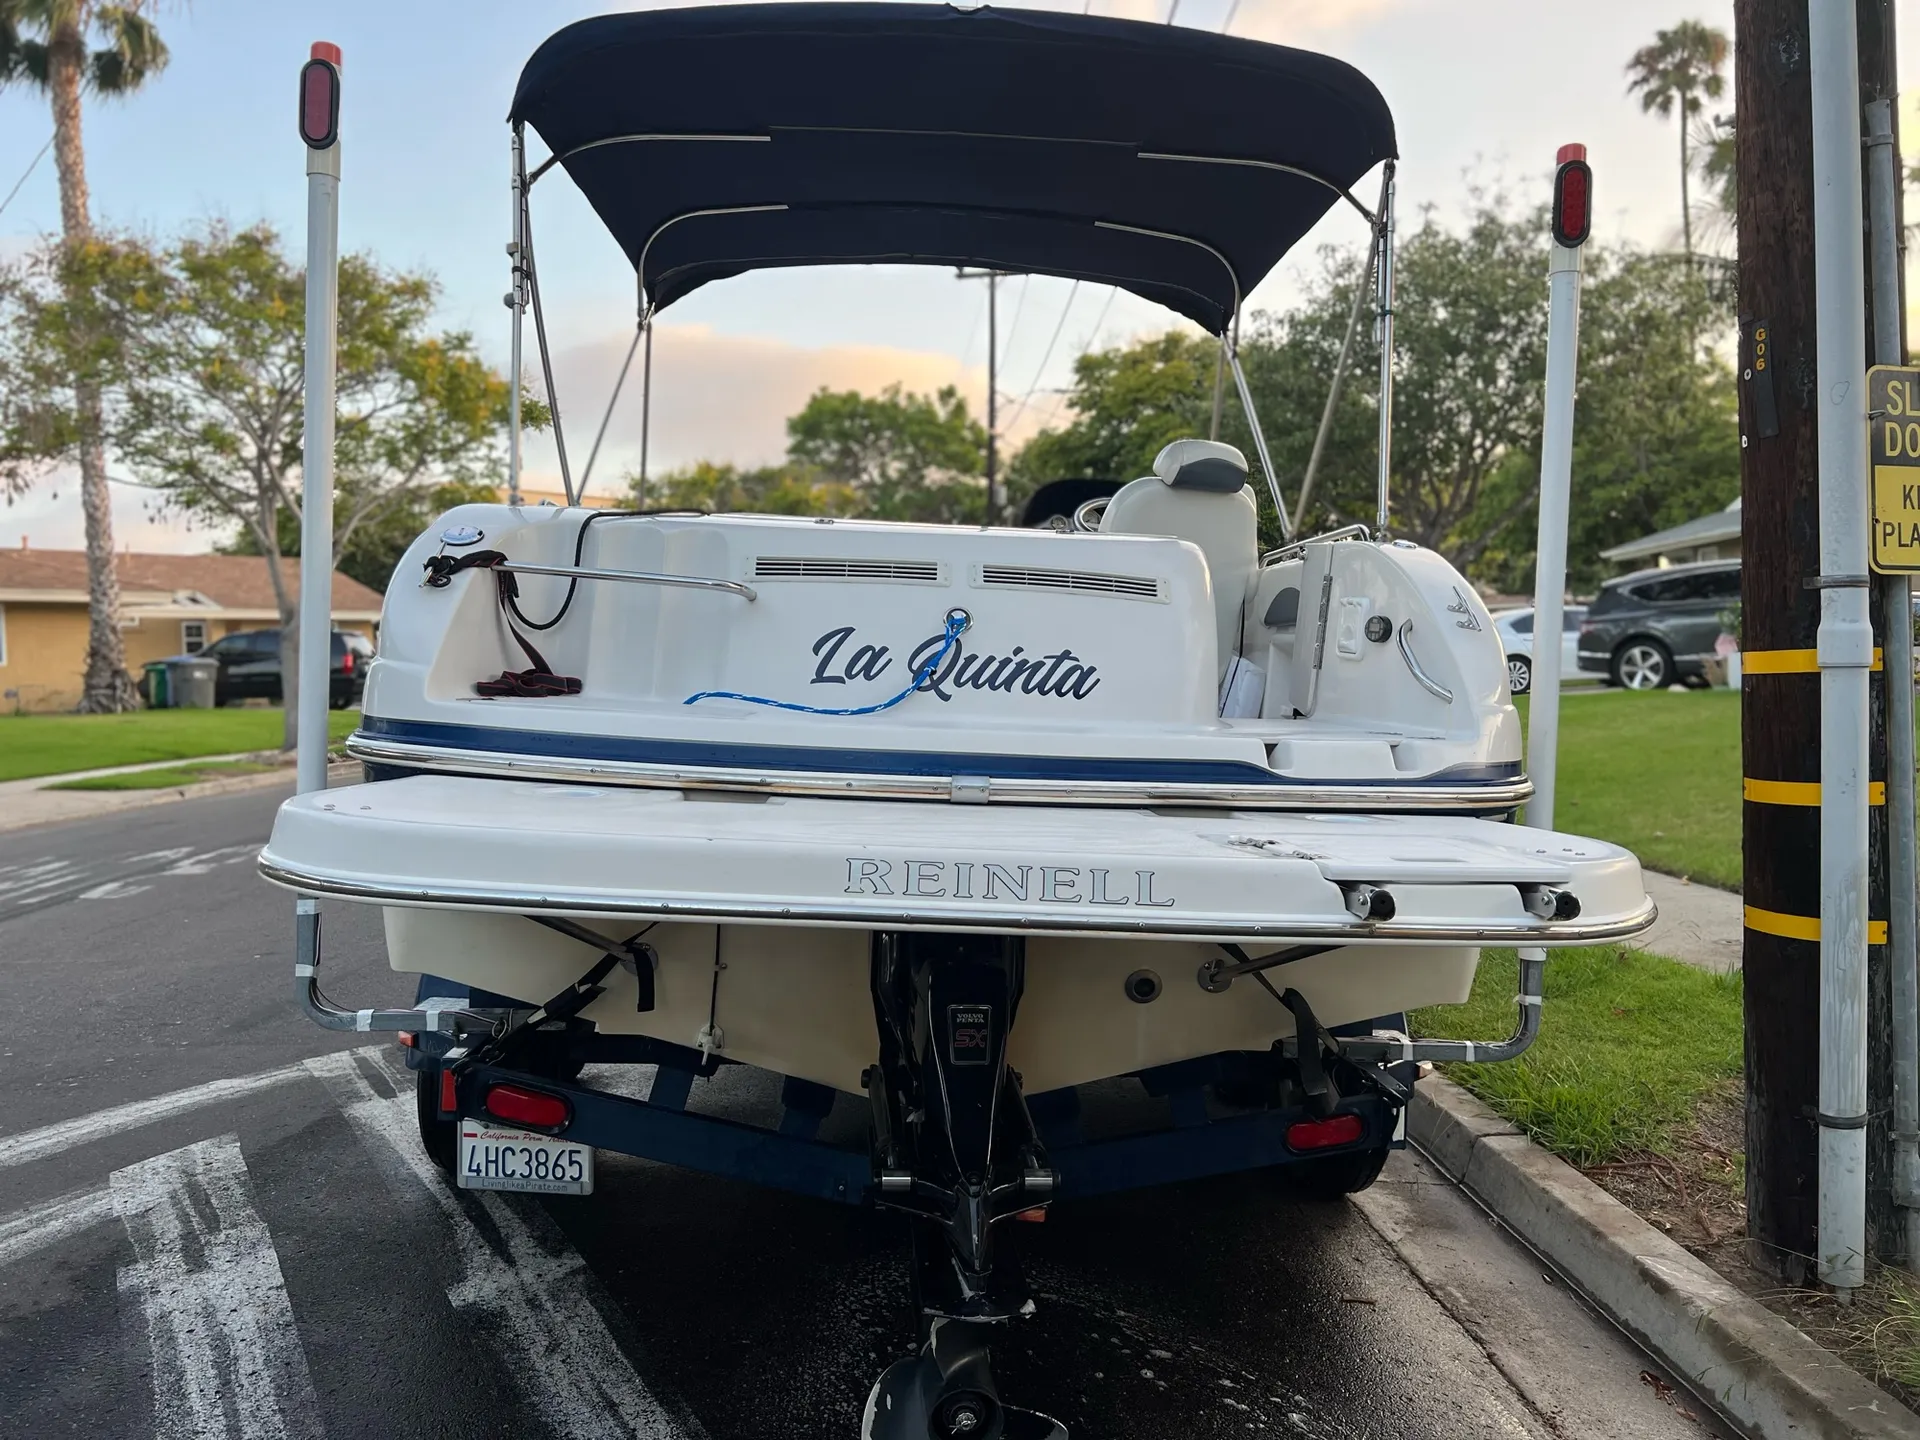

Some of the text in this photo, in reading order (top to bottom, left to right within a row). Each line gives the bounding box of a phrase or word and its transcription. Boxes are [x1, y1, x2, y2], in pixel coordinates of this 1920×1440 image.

[810, 626, 1101, 703] La Quinta
[844, 857, 1176, 907] REINELL
[954, 1028, 988, 1048] SX
[480, 1131, 519, 1141] California
[522, 1133, 543, 1142] Perm
[467, 1144, 583, 1182] 4HC3865
